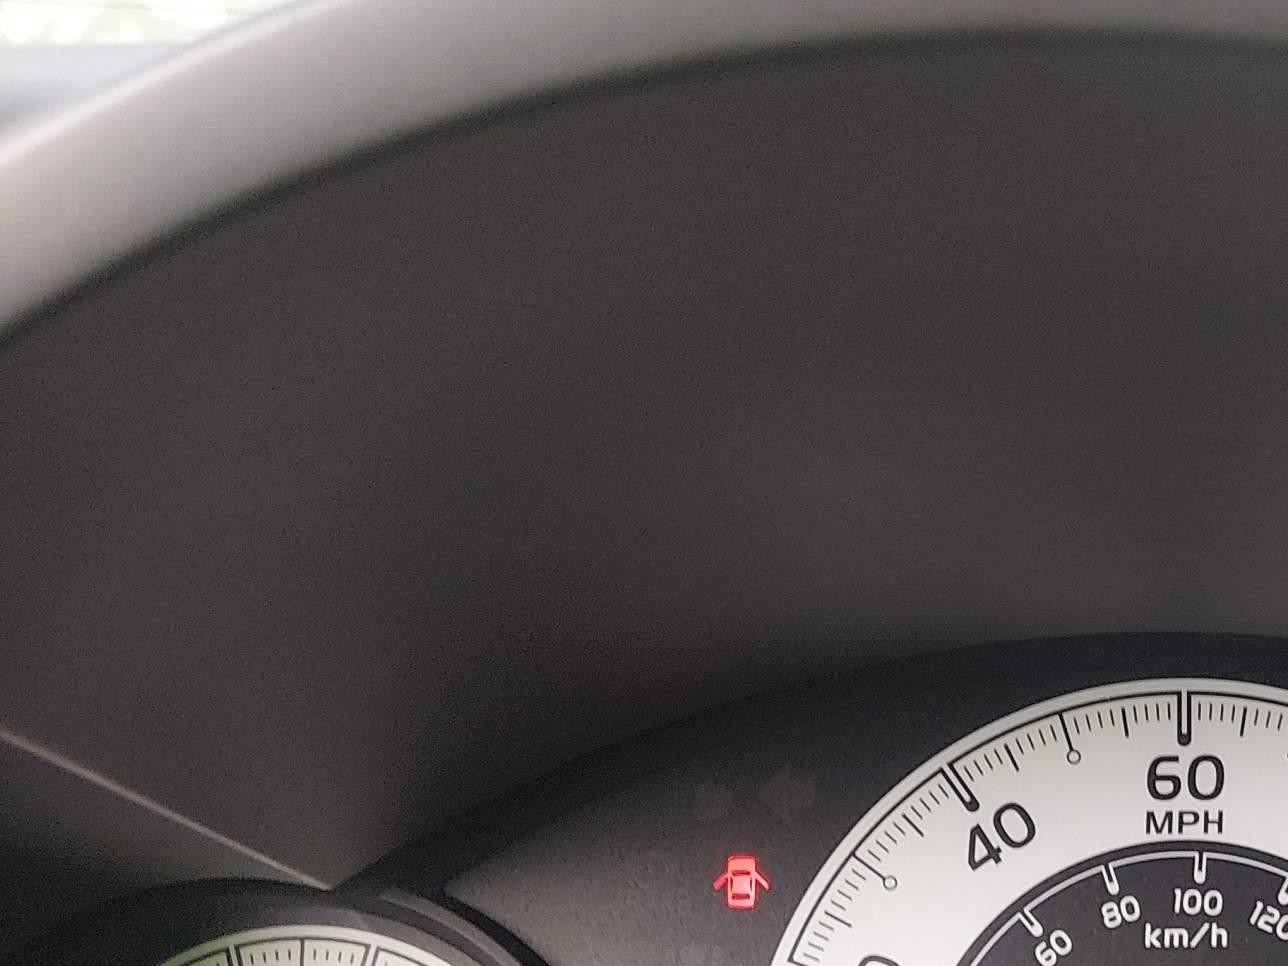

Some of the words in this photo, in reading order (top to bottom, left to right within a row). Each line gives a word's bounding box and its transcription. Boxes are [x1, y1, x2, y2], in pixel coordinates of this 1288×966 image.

[1147, 755, 1225, 800] 60
[966, 801, 1036, 871] 40
[1146, 810, 1223, 835] MPH
[1101, 894, 1140, 929] 80
[1174, 887, 1223, 916] 100
[1144, 922, 1228, 949] km/h
